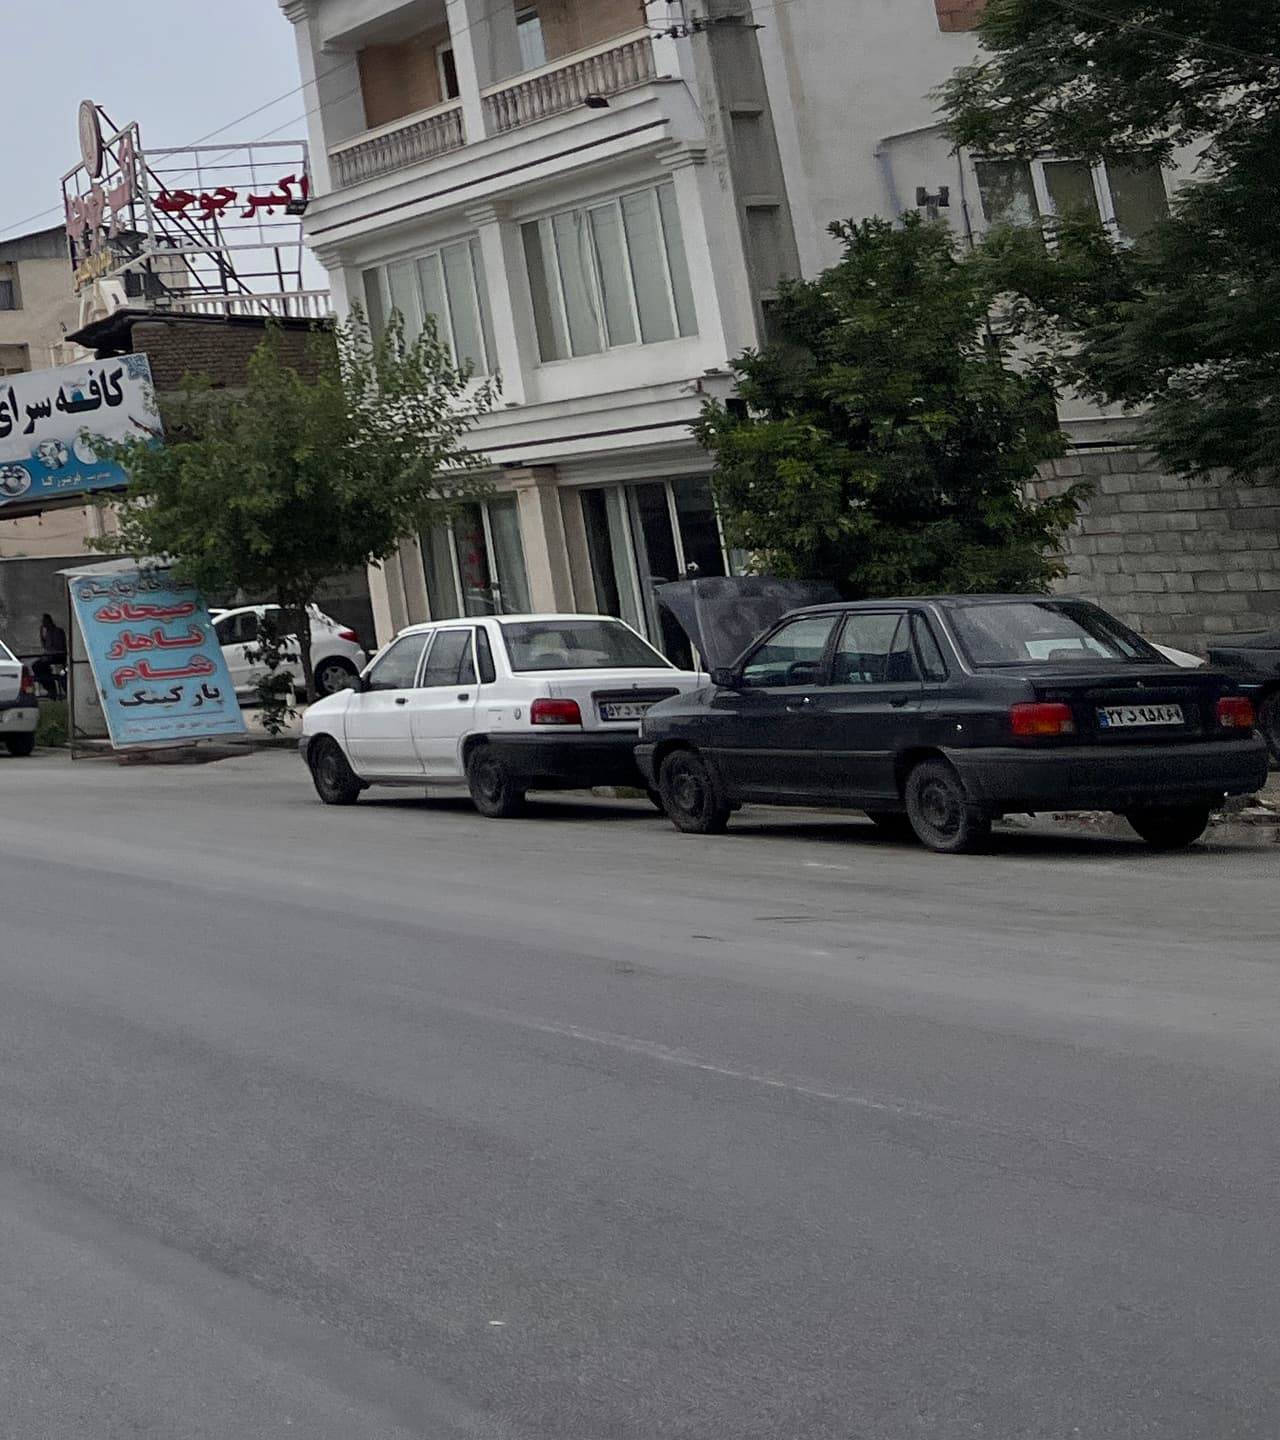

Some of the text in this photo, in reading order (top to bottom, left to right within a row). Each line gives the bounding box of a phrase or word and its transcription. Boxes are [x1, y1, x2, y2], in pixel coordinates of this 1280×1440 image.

[153, 174, 308, 221] اکبر جوجه
[55, 365, 123, 415] کافه
[95, 600, 196, 624] صبحانه
[106, 623, 205, 660] ناهار
[112, 654, 217, 689] شام
